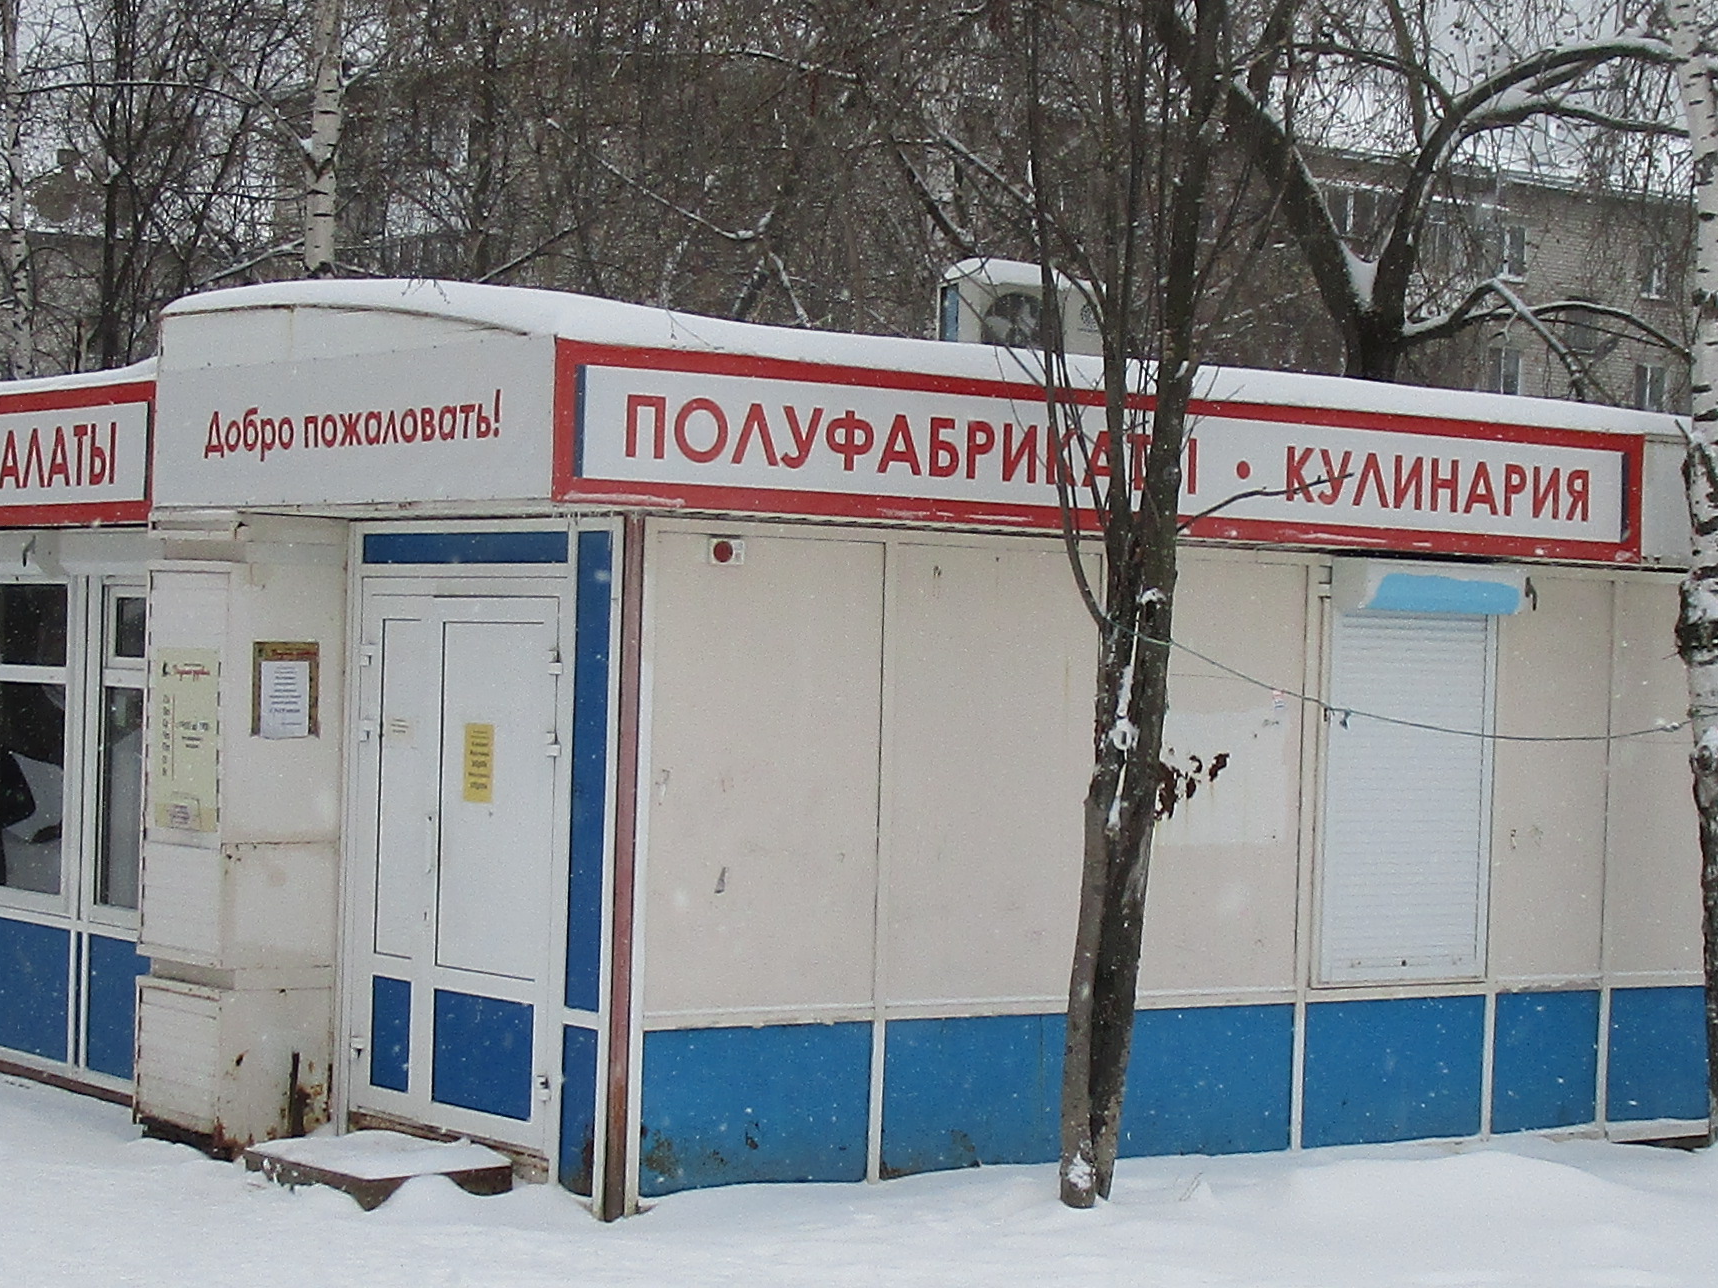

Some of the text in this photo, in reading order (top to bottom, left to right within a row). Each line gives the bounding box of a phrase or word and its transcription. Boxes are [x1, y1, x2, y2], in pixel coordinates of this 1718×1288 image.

[204, 389, 502, 462] Добро пожаловать!
[1285, 445, 1591, 523] КУЛИНАРИЯ
